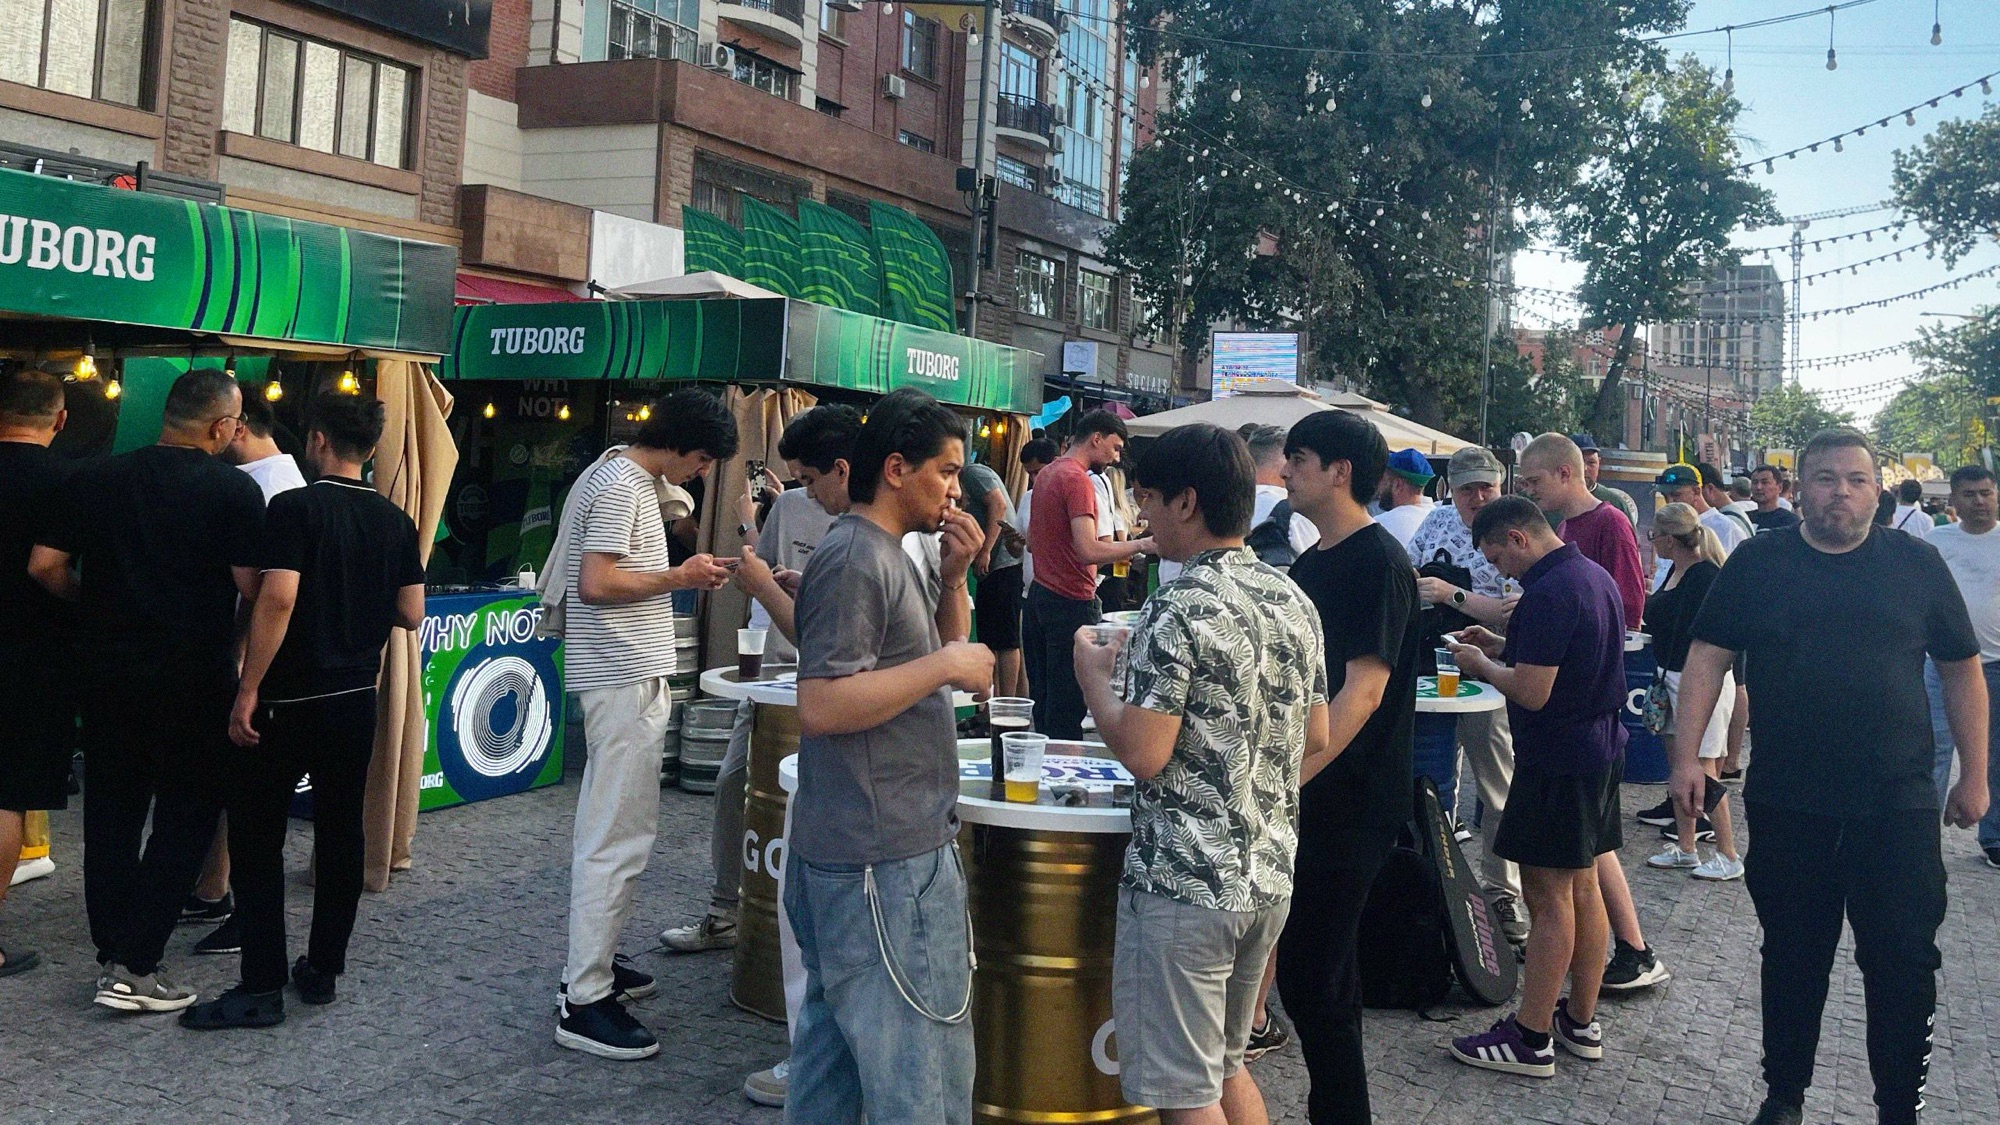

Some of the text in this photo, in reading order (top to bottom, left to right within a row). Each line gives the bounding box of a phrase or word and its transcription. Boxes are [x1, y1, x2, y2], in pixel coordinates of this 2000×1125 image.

[0, 213, 156, 282] UBORG
[490, 326, 586, 355] TUBORG
[906, 347, 960, 381] TUBORG
[1127, 372, 1168, 395] SOCIALS
[1468, 892, 1501, 978] prince
